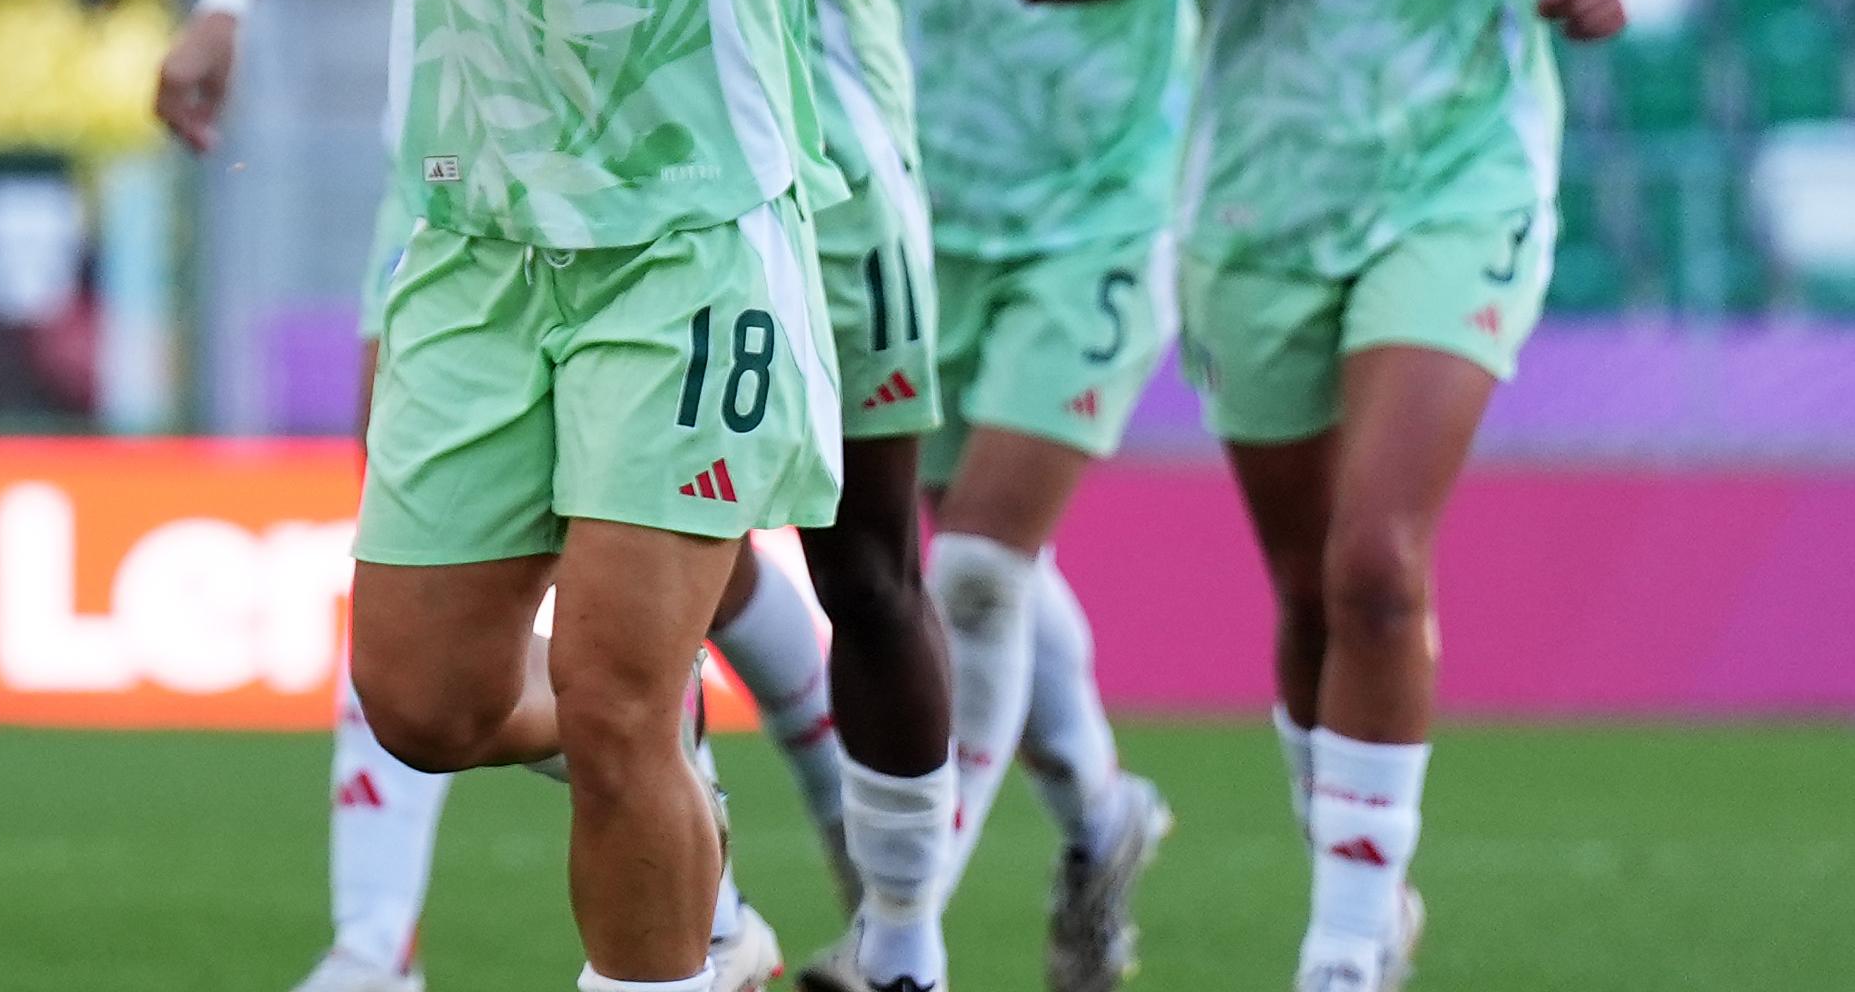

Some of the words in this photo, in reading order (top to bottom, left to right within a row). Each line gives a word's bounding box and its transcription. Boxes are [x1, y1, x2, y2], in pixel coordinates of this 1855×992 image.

[865, 241, 920, 352] 11
[1482, 206, 1532, 288] 3
[1081, 266, 1138, 366] 5
[677, 304, 776, 435] 18
